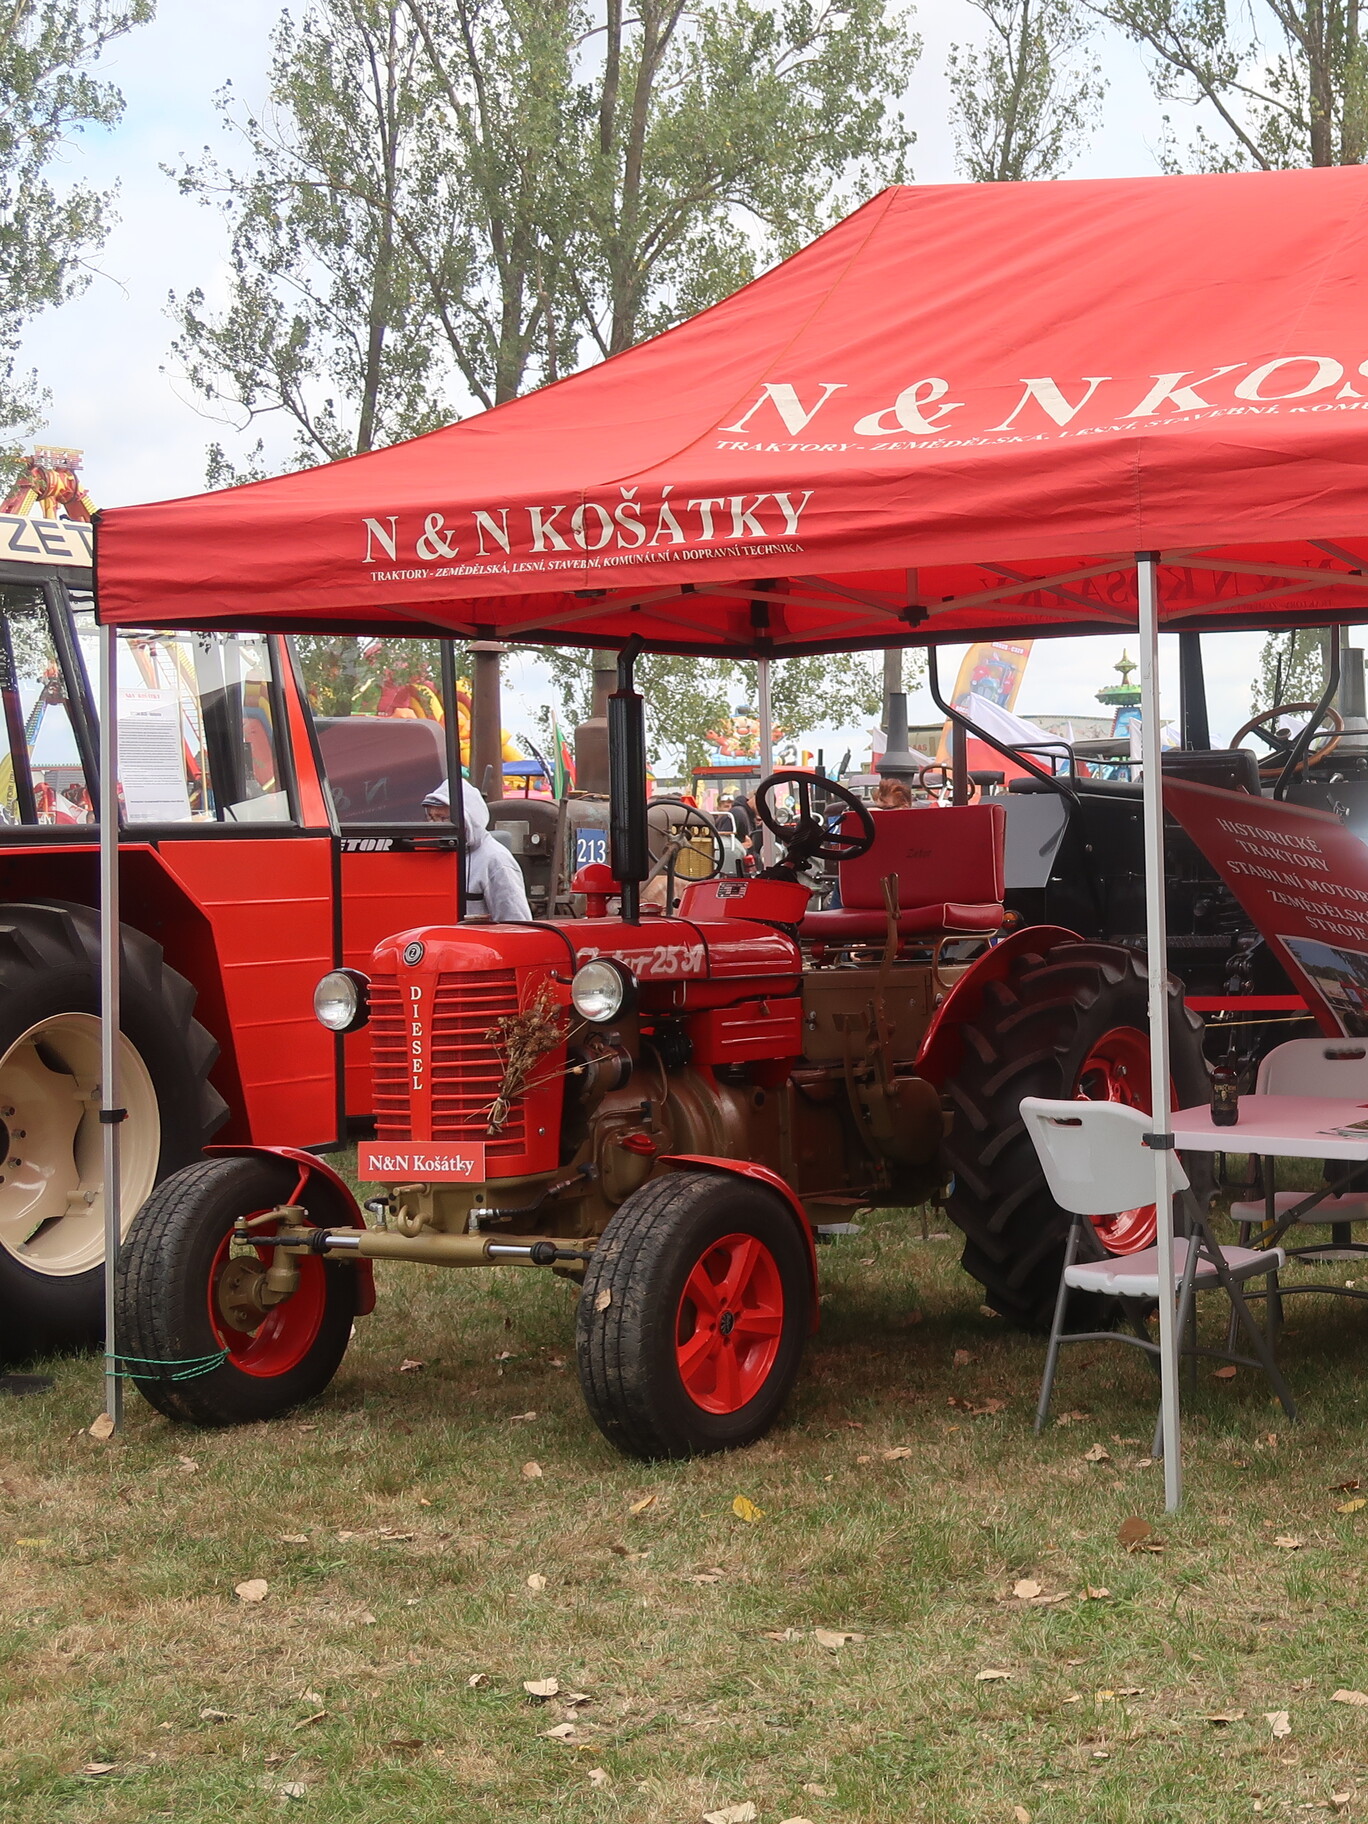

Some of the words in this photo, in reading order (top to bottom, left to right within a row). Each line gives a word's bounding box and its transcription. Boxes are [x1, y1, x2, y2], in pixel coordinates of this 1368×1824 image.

[718, 382, 848, 436] N
[853, 377, 965, 436] &
[984, 376, 1112, 433] N
[716, 440, 856, 453] TRAKTORY
[362, 516, 399, 563] N
[416, 512, 459, 561] &
[471, 508, 511, 556] N
[525, 485, 815, 553] KOŠÁTKY
[371, 568, 430, 581] TRAKTORY
[603, 549, 670, 567] KOMUNÁLNÍ
[672, 552, 681, 562] A
[682, 544, 740, 561] DOPRAVNÍ
[741, 542, 804, 556] TECHNIKA
[577, 838, 607, 863] 213
[1216, 817, 1323, 854] HISTORICKÉ
[1235, 839, 1331, 872] TRAKTORY
[1226, 860, 1305, 889] STABILNÍ
[410, 986, 423, 1090] DIESEL
[368, 1155, 409, 1171] N&N
[413, 1154, 475, 1176] Košátky
